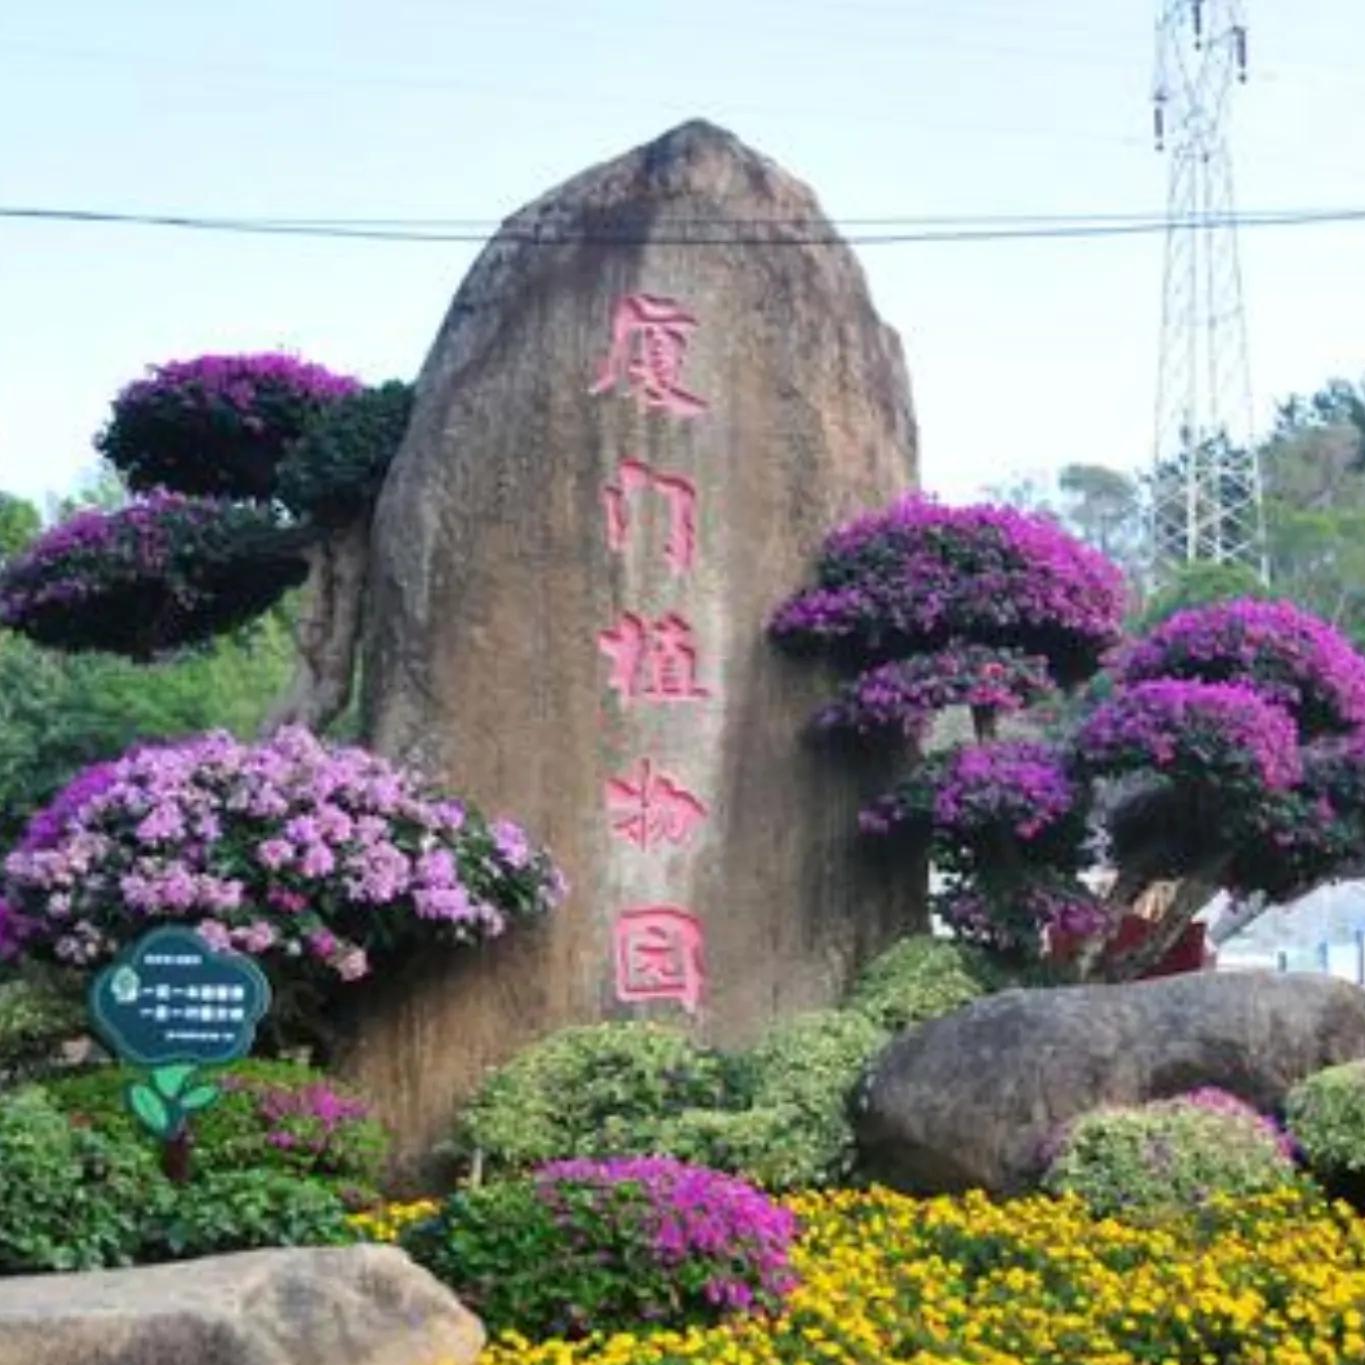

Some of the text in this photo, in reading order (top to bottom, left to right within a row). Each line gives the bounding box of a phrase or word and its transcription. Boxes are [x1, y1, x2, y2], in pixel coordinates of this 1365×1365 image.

[592, 292, 710, 1010] 厦门植物园
